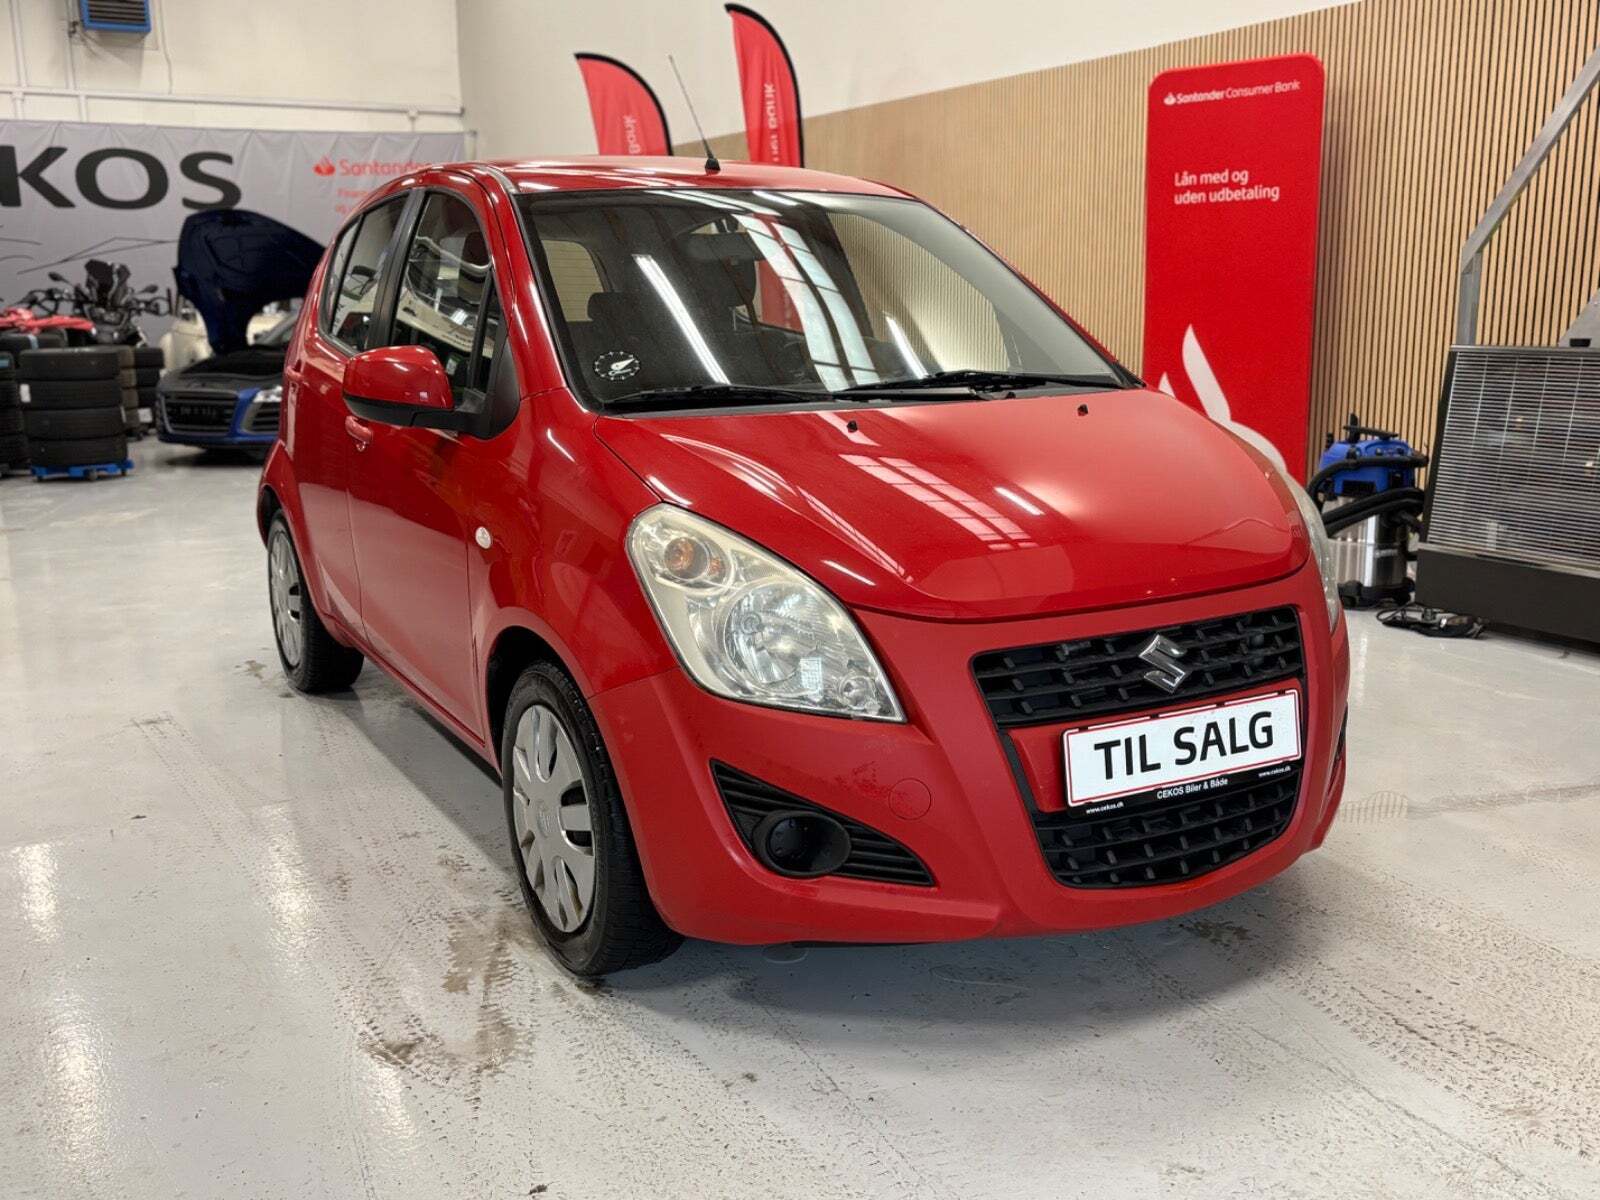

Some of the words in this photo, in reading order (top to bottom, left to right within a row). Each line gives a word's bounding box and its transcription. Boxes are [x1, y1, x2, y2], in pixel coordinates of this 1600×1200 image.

[1175, 90, 1226, 104] Santander
[1226, 83, 1275, 99] Consumer
[1275, 80, 1300, 93] Bank
[339, 159, 430, 176] Santand
[1174, 171, 1197, 187] Lån
[1200, 169, 1229, 184] med
[1231, 169, 1249, 185] og
[1174, 189, 1206, 205] uden
[1208, 186, 1280, 202] udbetaling
[1093, 733, 1162, 780] TIL
[1173, 710, 1274, 766] SALG
[1258, 765, 1291, 777] www.cekos.dk
[1156, 786, 1184, 800] CEKOS
[1185, 782, 1203, 794] Biler
[1203, 780, 1209, 791] &
[1210, 777, 1229, 789] Både
[1086, 801, 1124, 814] www.cekos.dk
